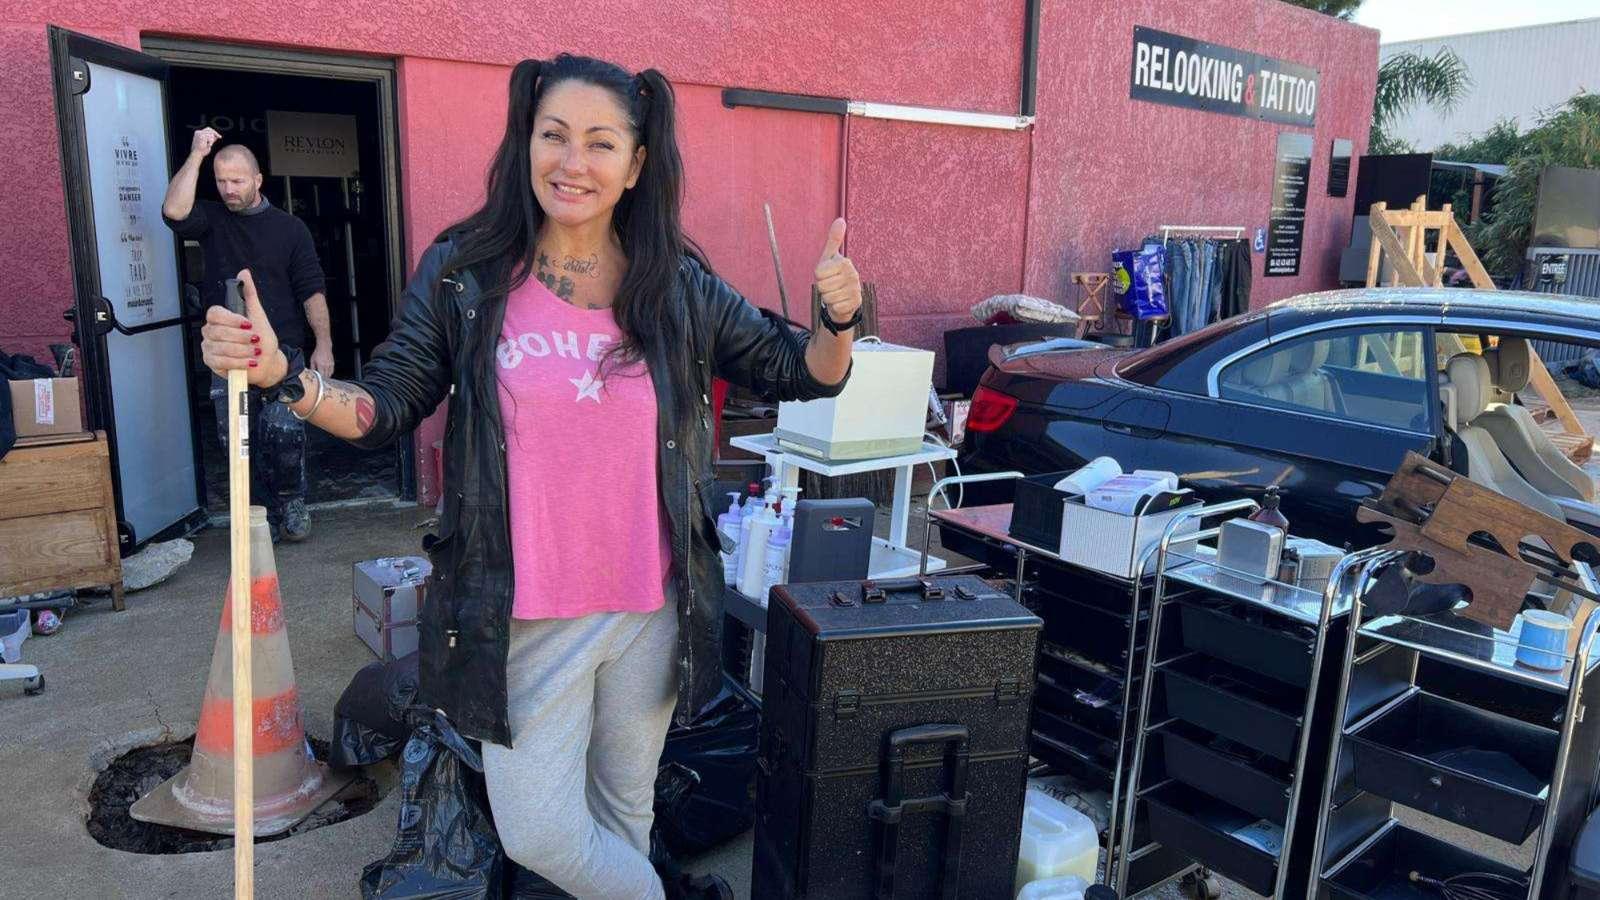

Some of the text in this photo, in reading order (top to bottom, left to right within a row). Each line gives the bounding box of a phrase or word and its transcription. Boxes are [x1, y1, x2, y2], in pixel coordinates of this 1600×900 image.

[1135, 42, 1316, 116] RELOOKING & TATTOO
[115, 149, 138, 160] VIVRE
[284, 136, 344, 149] REVLON
[496, 330, 630, 369] BOHE
